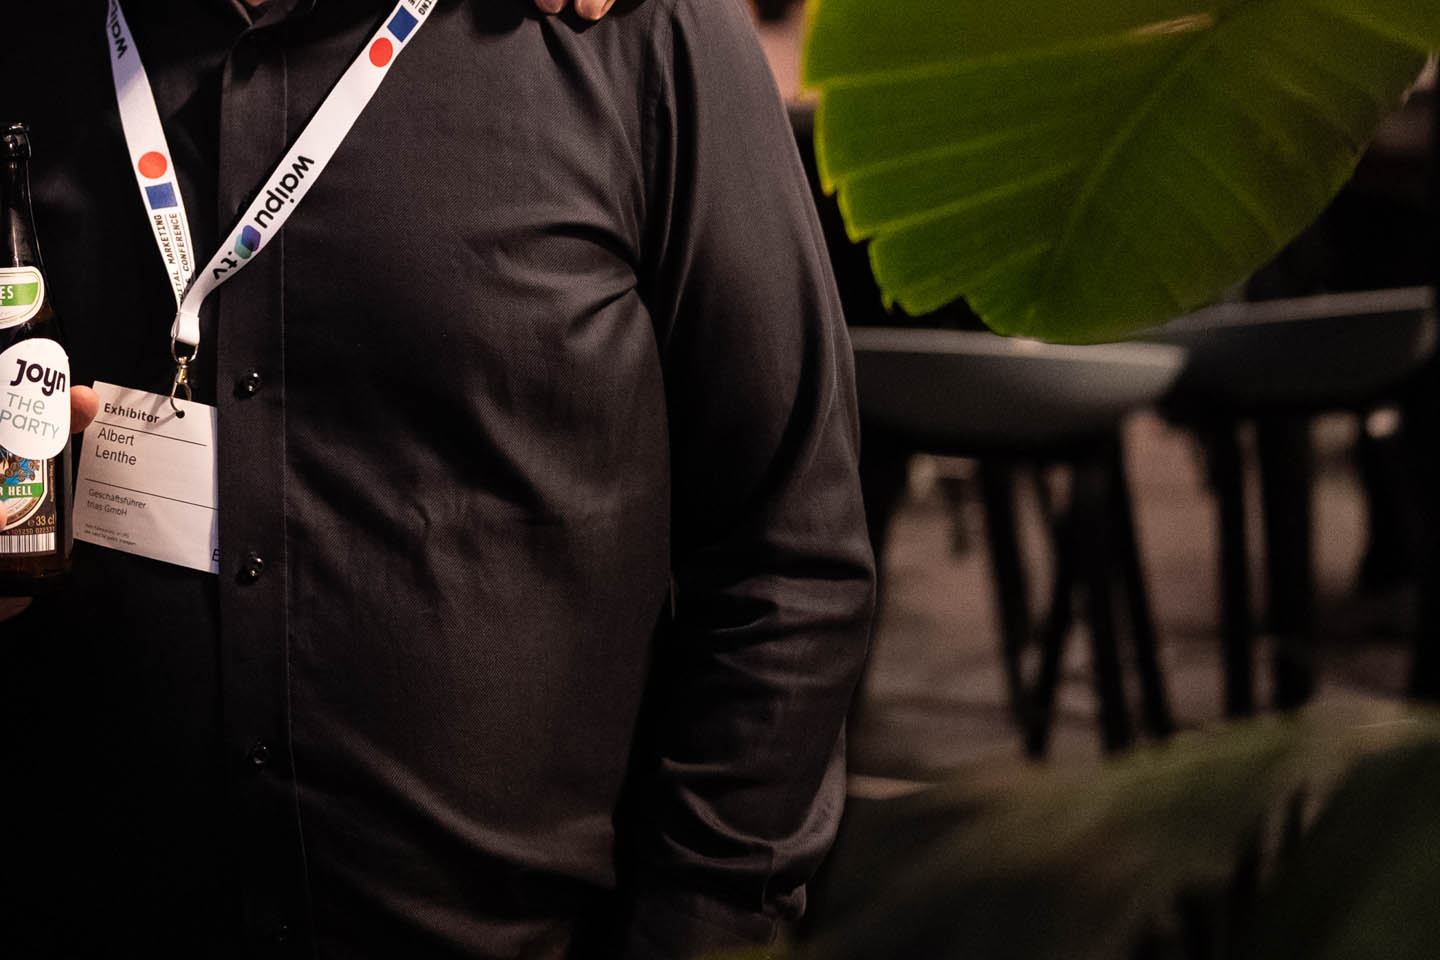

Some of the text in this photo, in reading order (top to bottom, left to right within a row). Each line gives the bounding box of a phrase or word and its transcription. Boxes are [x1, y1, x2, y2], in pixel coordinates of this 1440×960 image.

[254, 155, 315, 229] waipu
[153, 214, 176, 265] MARKETING
[168, 213, 190, 272] CONFERENCE
[10, 358, 66, 397] Joyn
[103, 402, 160, 424] Exhibitor
[97, 427, 135, 447] Albert
[95, 445, 137, 466] Lenthe
[8, 485, 33, 496] HELL
[35, 514, 55, 526] 33 cl
[104, 504, 128, 517] GmbH
